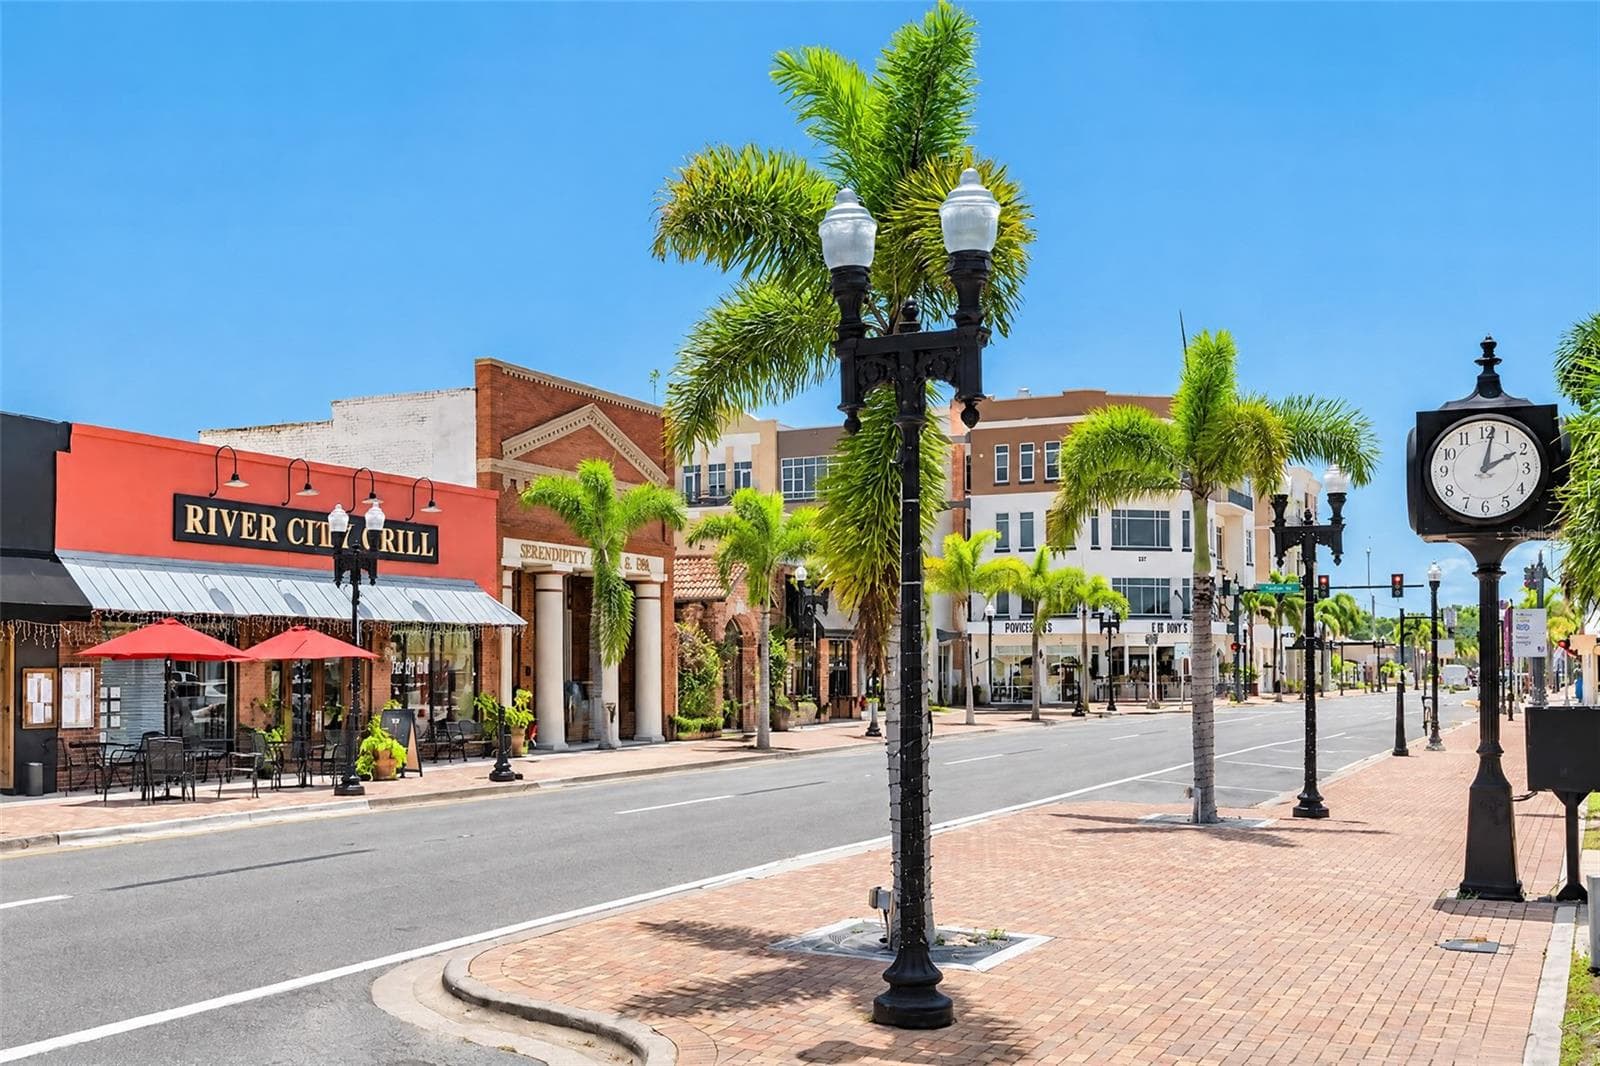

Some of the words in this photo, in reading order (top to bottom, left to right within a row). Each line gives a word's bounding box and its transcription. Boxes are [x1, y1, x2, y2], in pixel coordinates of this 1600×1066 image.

[1459, 432, 1469, 446] 11
[1479, 426, 1495, 440] 12
[1505, 430, 1510, 444] 1
[1444, 448, 1456, 460] 10
[1519, 442, 1528, 456] 2
[1439, 465, 1449, 478] 9
[1522, 462, 1531, 475] 3
[1445, 484, 1454, 497] 8
[1516, 482, 1526, 495] 4
[1462, 497, 1470, 510] 7
[1481, 500, 1490, 514] 6
[1501, 495, 1510, 509] 5
[183, 503, 279, 543] RIVER
[519, 543, 587, 564] SERENDIPITY
